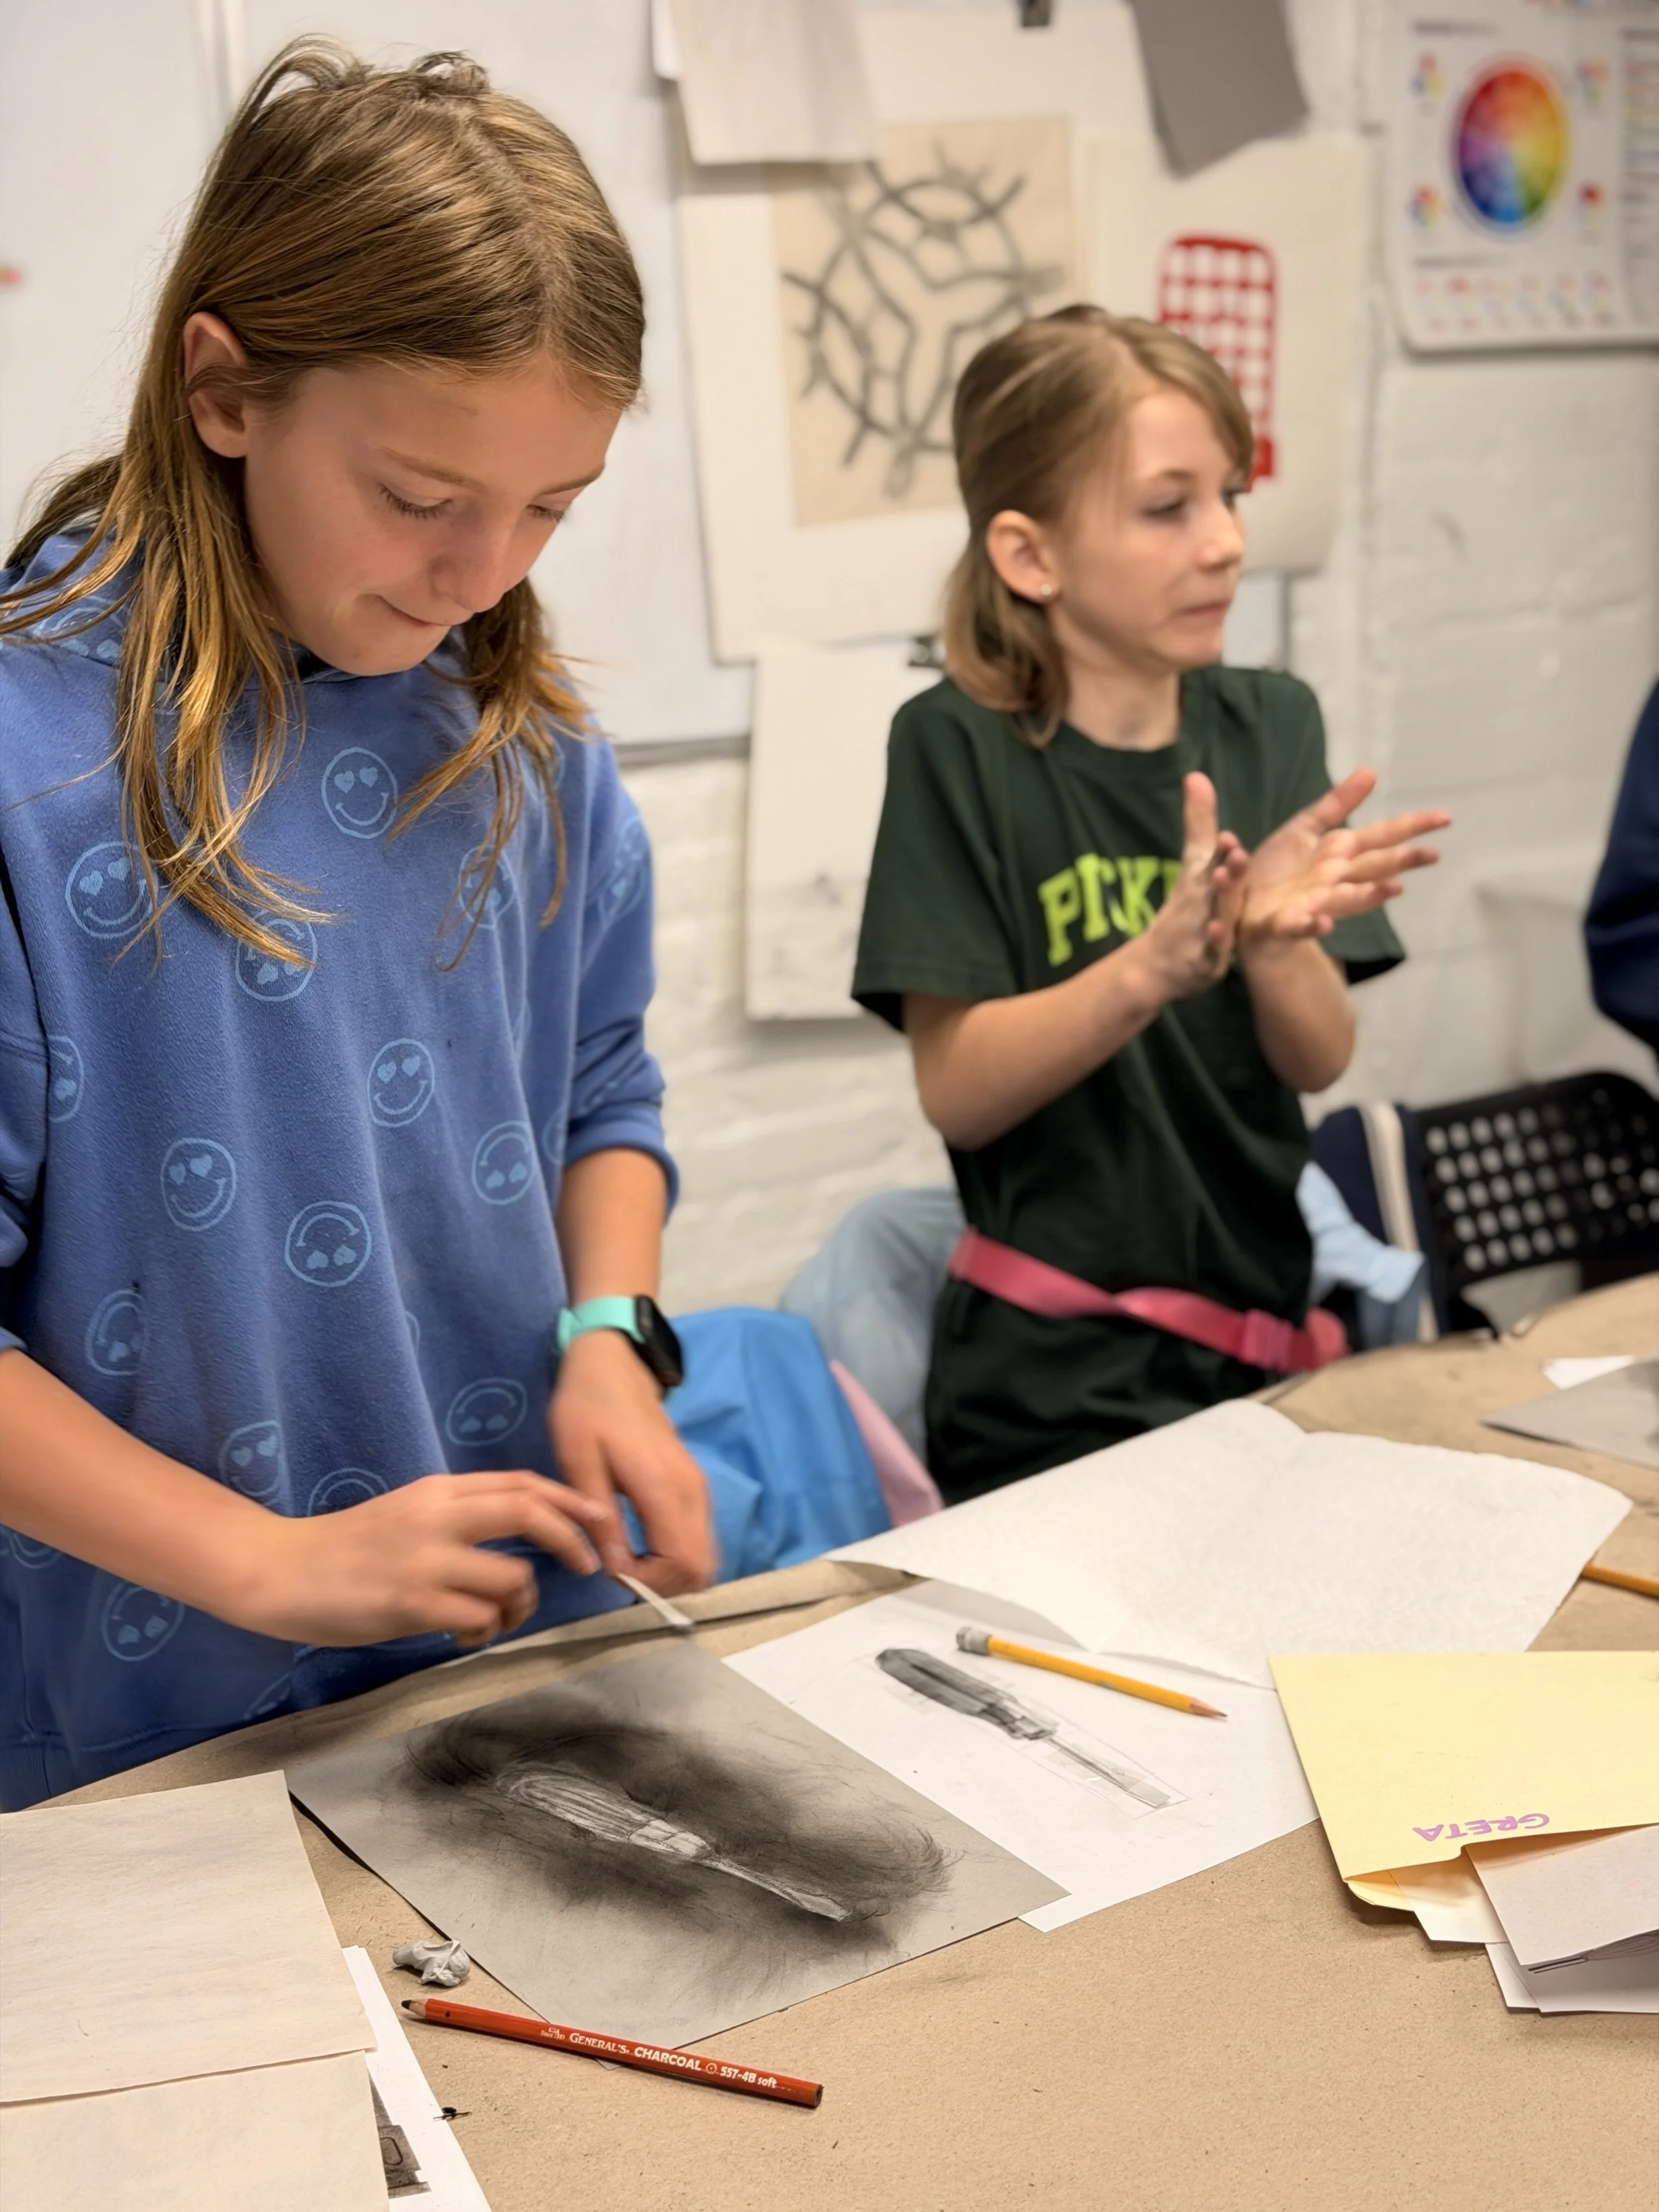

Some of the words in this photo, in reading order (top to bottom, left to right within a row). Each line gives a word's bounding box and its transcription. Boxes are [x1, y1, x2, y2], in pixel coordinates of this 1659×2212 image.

[1412, 1813, 1550, 1842] GRETA
[634, 2047, 701, 2071] CHARCOAL
[720, 2066, 757, 2083] 557-4B
[757, 2077, 777, 2089] soft
